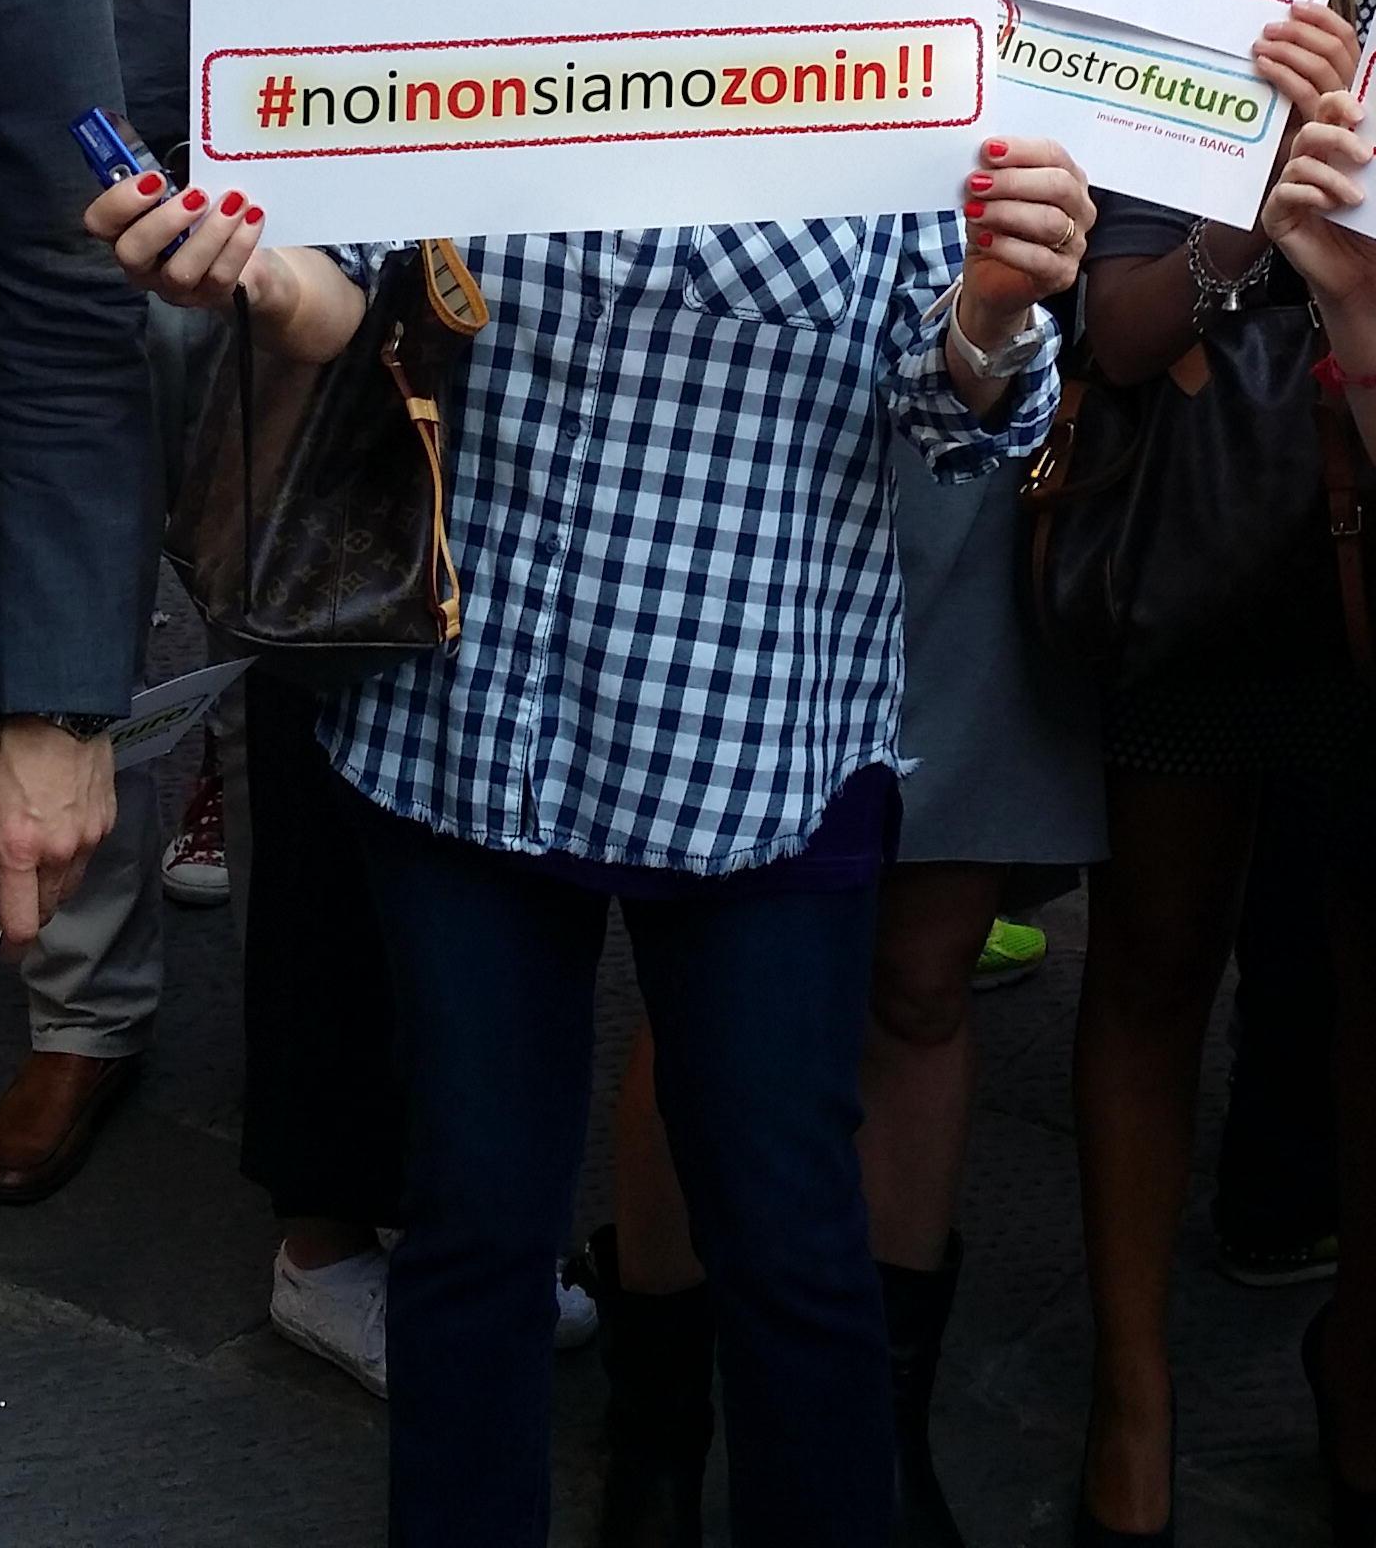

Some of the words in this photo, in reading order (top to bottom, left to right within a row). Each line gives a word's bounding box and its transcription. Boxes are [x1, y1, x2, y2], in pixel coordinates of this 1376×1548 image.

[257, 44, 934, 129] #noinonsiamozonin!!
[1097, 112, 1134, 128] Insieme
[1135, 121, 1152, 134] per
[1154, 124, 1164, 136] la
[1165, 130, 1197, 144] nostra
[1199, 136, 1245, 158] BANCA
